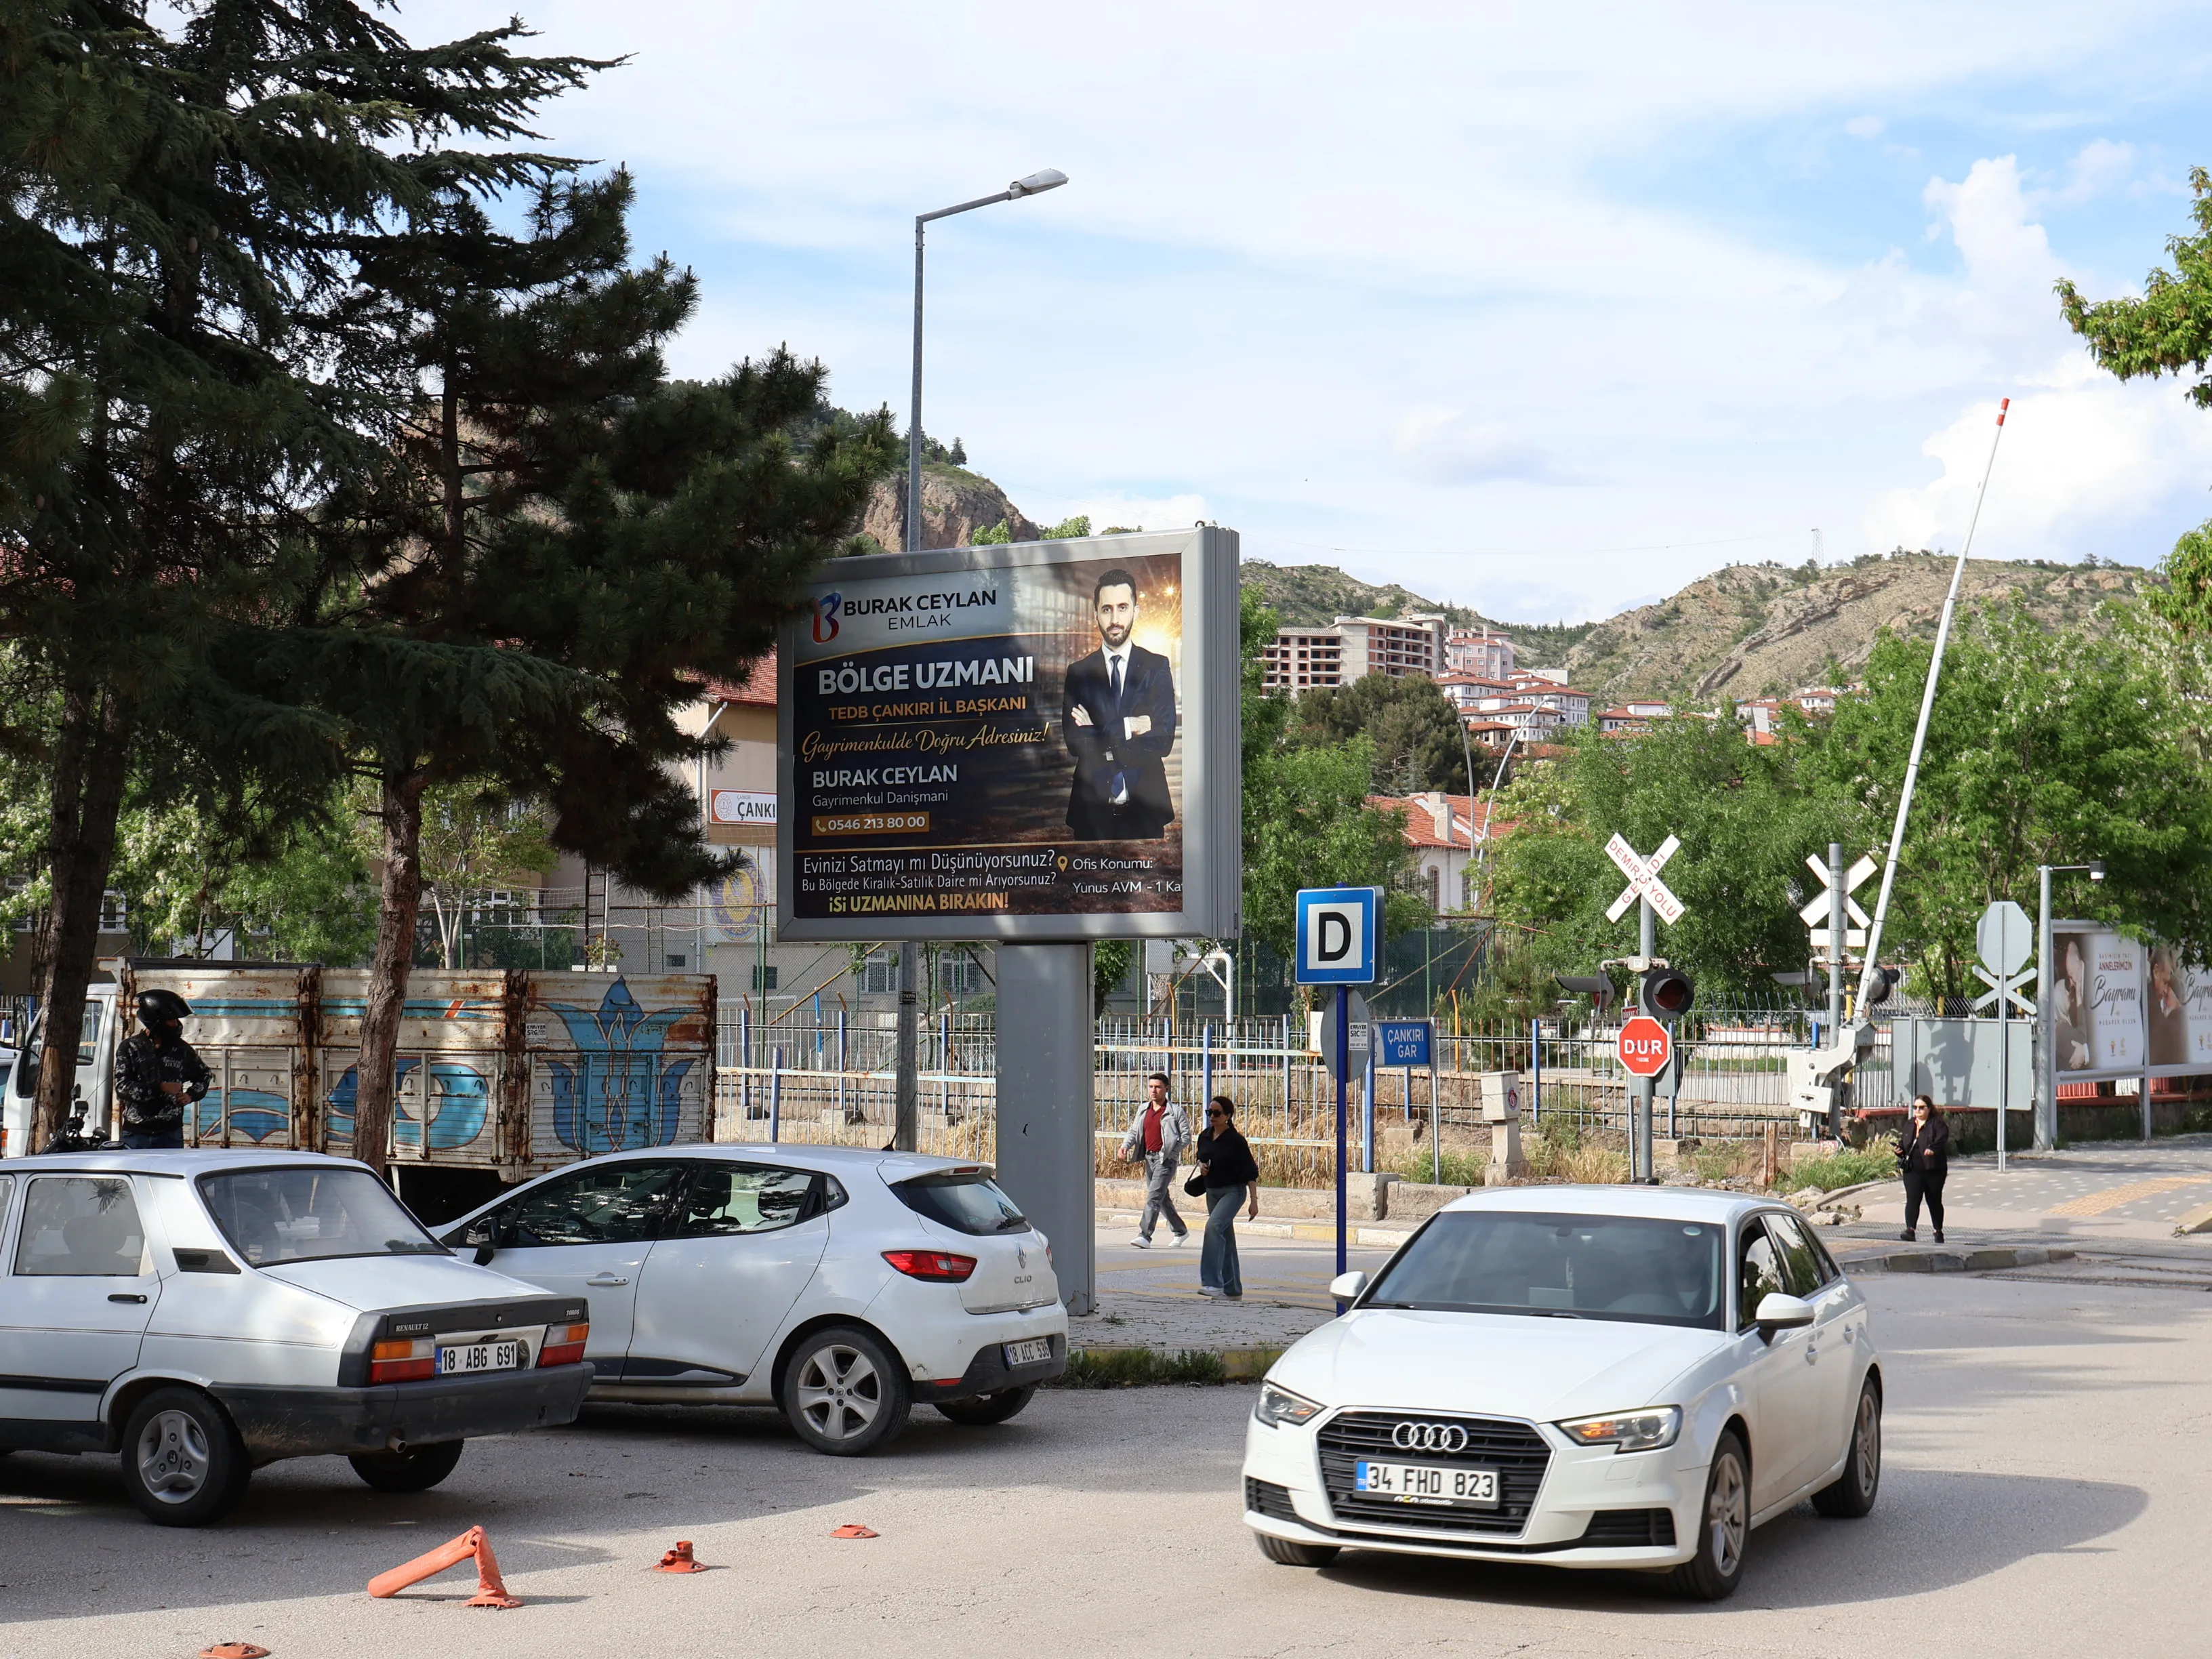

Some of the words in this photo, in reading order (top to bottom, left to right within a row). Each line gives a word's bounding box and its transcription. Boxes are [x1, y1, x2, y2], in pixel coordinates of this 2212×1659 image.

[844, 596, 913, 616] BURAK
[916, 590, 996, 611] CEYLAN
[888, 613, 951, 630] EMLAK
[819, 661, 909, 695] BÖLGE
[916, 655, 1033, 689] UZMANI
[829, 705, 868, 720] TEDB
[872, 702, 934, 722] ÇANKIRI
[939, 697, 951, 714] İL
[956, 696, 1026, 716] BAŞKANI
[802, 731, 914, 763] Gayrimenkulde
[915, 729, 966, 755] Doğru
[965, 722, 1050, 750] Adresiniz!
[813, 769, 879, 788] BURAK
[882, 764, 958, 785] CEYLAN
[813, 792, 883, 809] Gayrimenkul
[828, 819, 860, 831] 0546
[863, 818, 884, 829] 213
[887, 817, 904, 827] 80
[907, 816, 926, 827] 00
[804, 857, 845, 873] Evinizi
[851, 856, 904, 874] Satmayı
[909, 858, 926, 870] mı
[932, 849, 1055, 874] Düşünüyorsunuz?
[1073, 858, 1097, 870] Ofis
[1101, 858, 1153, 869] Konumu:
[802, 879, 815, 891] Bu
[819, 878, 859, 893] Bölgede
[863, 875, 934, 890] Kiralık-Satılık
[937, 875, 965, 888] Daire
[969, 874, 982, 886] mi
[985, 872, 1057, 888] Arıyorsunuz?
[1073, 882, 1108, 893] Yunus
[1111, 881, 1141, 893] AVM
[1155, 881, 1161, 892] 1
[1166, 881, 1183, 892] Ka
[851, 894, 936, 912] UZMANINA
[940, 892, 1008, 909] BIRAKIN!
[1650, 885, 1677, 917] YOLU
[1318, 912, 1351, 962] D
[1387, 1029, 1424, 1045] ÇANKIRI
[1624, 1039, 1663, 1055] DUR
[1397, 1044, 1417, 1058] GAR
[1014, 1275, 1032, 1284] CLIO
[396, 1324, 423, 1332] RENAULT
[443, 1349, 456, 1371] 18
[466, 1347, 487, 1369] ABG
[497, 1344, 515, 1366] 691
[1009, 1347, 1019, 1364] 18
[1021, 1343, 1034, 1361] ACC
[1036, 1340, 1050, 1359] 536
[1369, 1467, 1393, 1490] 34
[1404, 1469, 1441, 1494] FHD
[1455, 1473, 1493, 1498] 823
